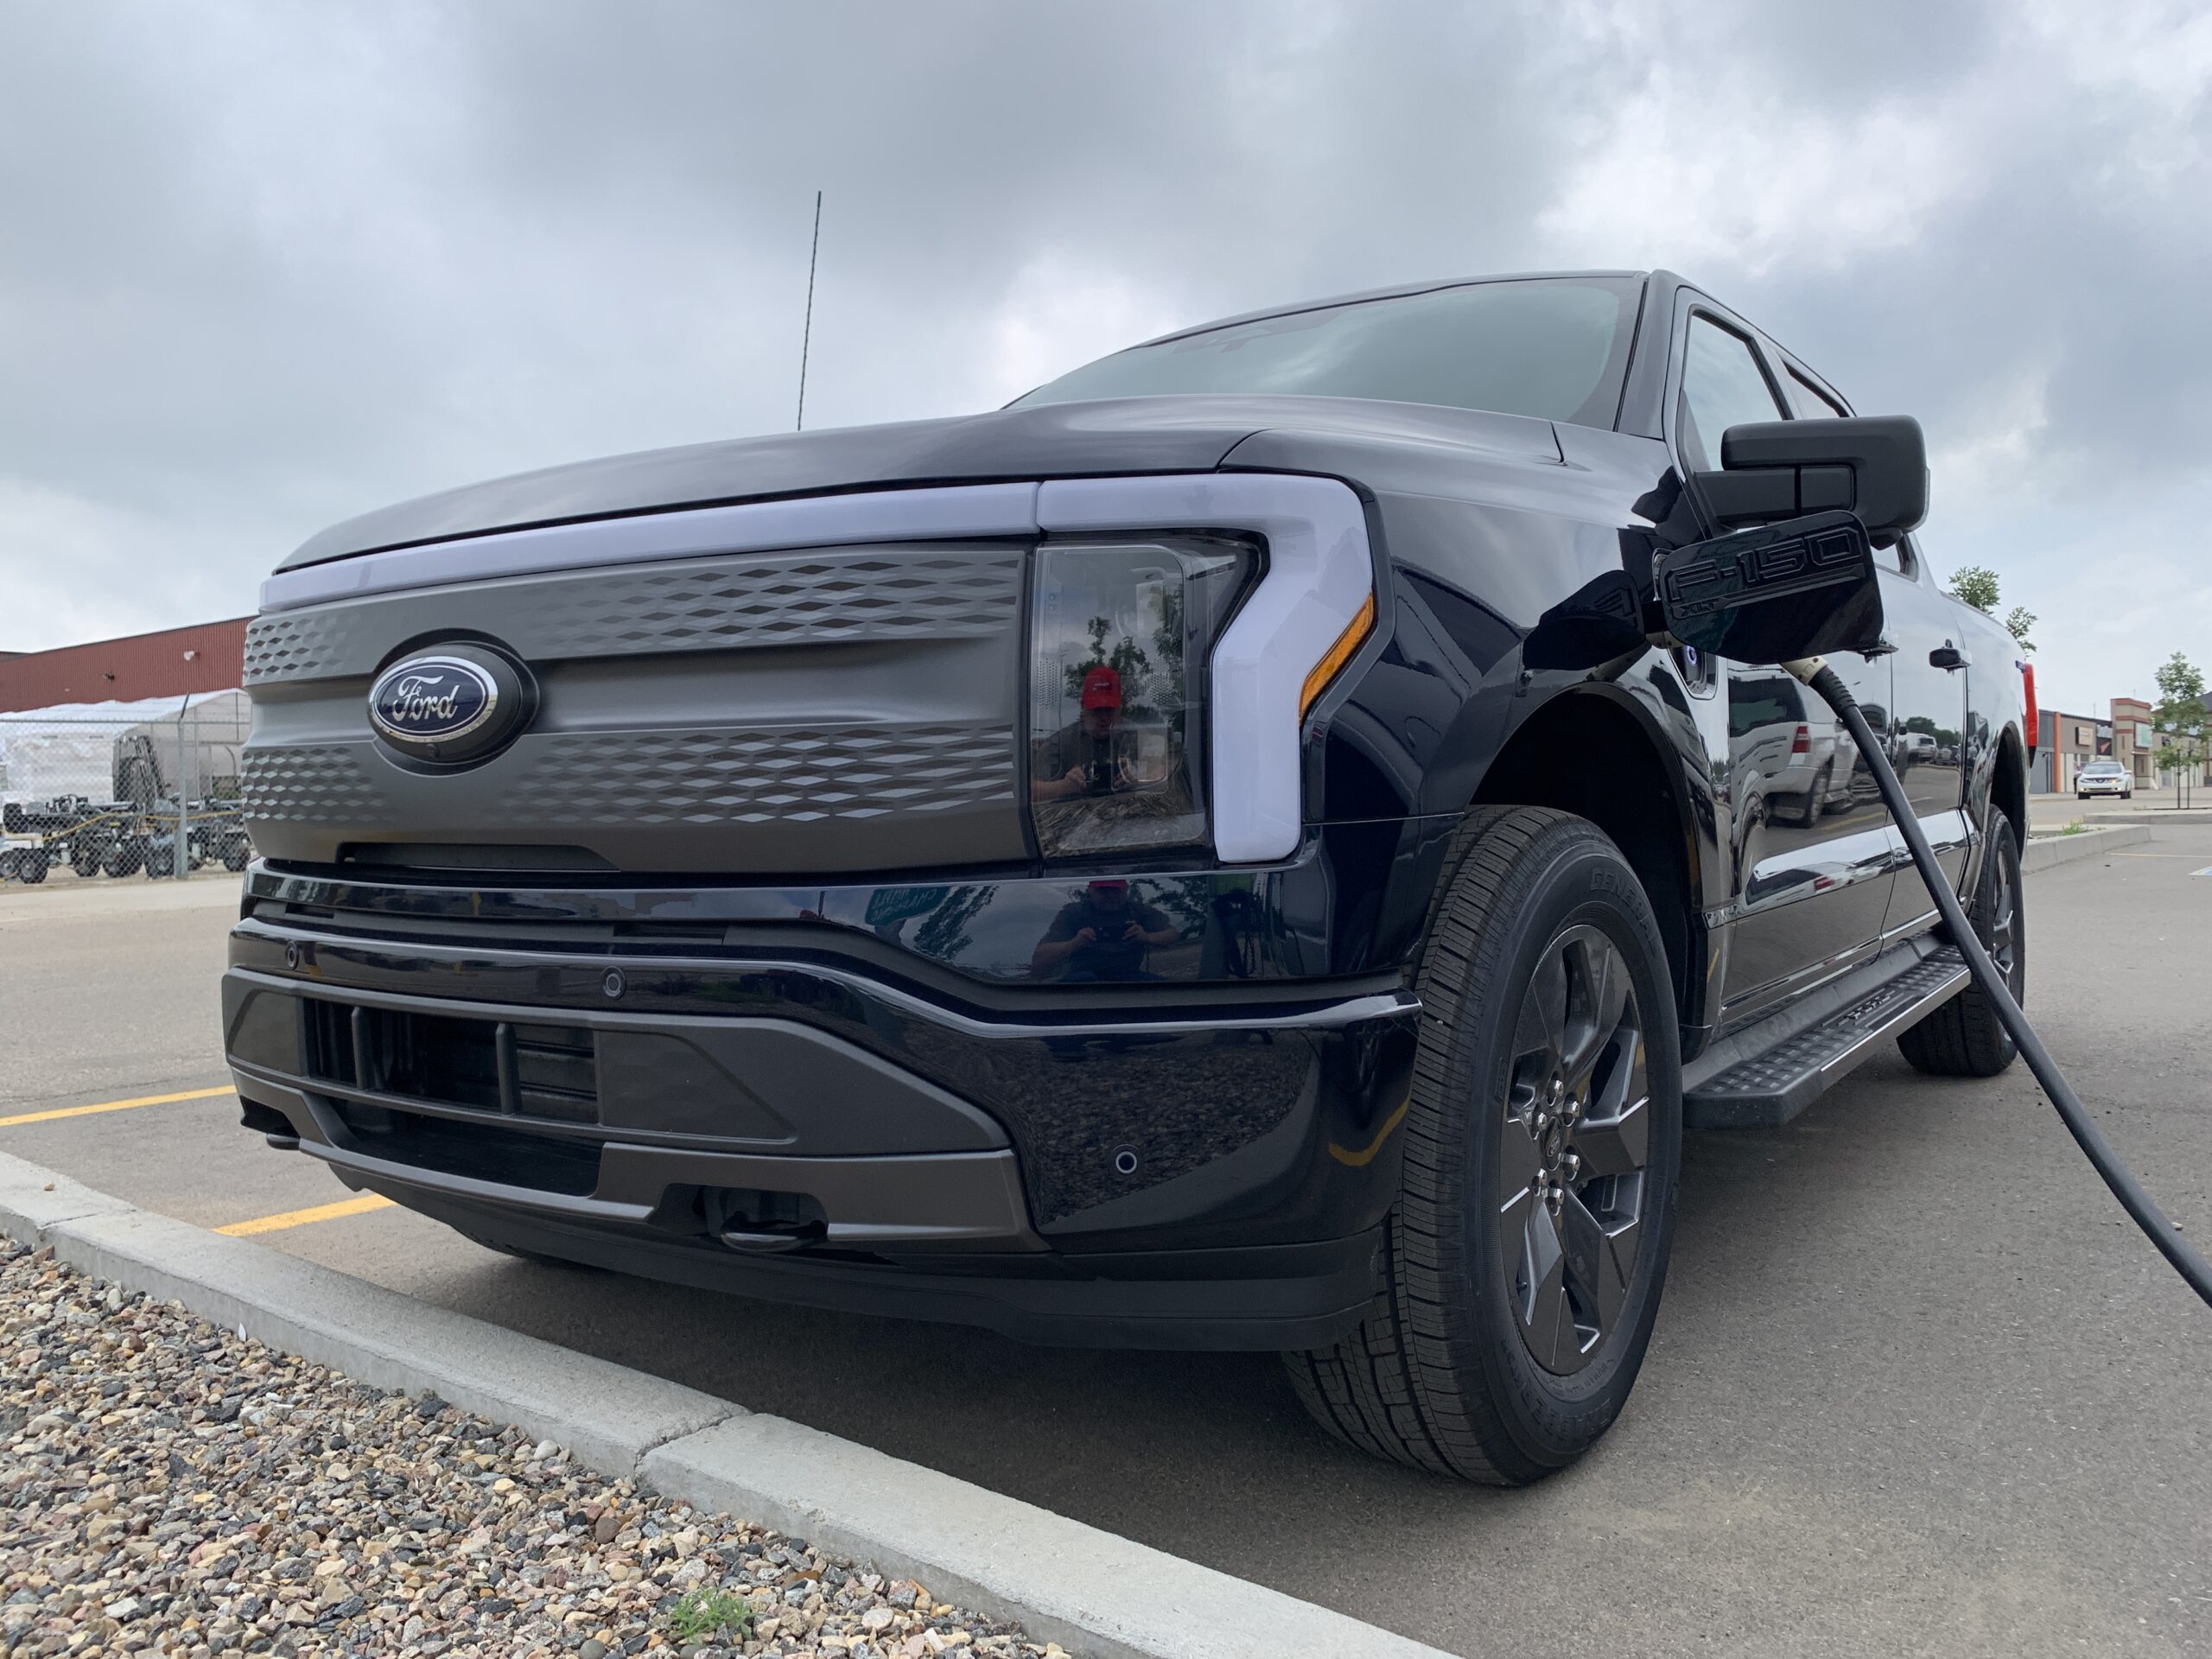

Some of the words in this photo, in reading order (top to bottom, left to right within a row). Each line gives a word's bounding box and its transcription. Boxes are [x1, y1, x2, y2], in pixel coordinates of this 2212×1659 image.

[1665, 526, 1864, 602] F-150
[1679, 598, 1719, 618] XLT
[391, 675, 461, 722] Ford
